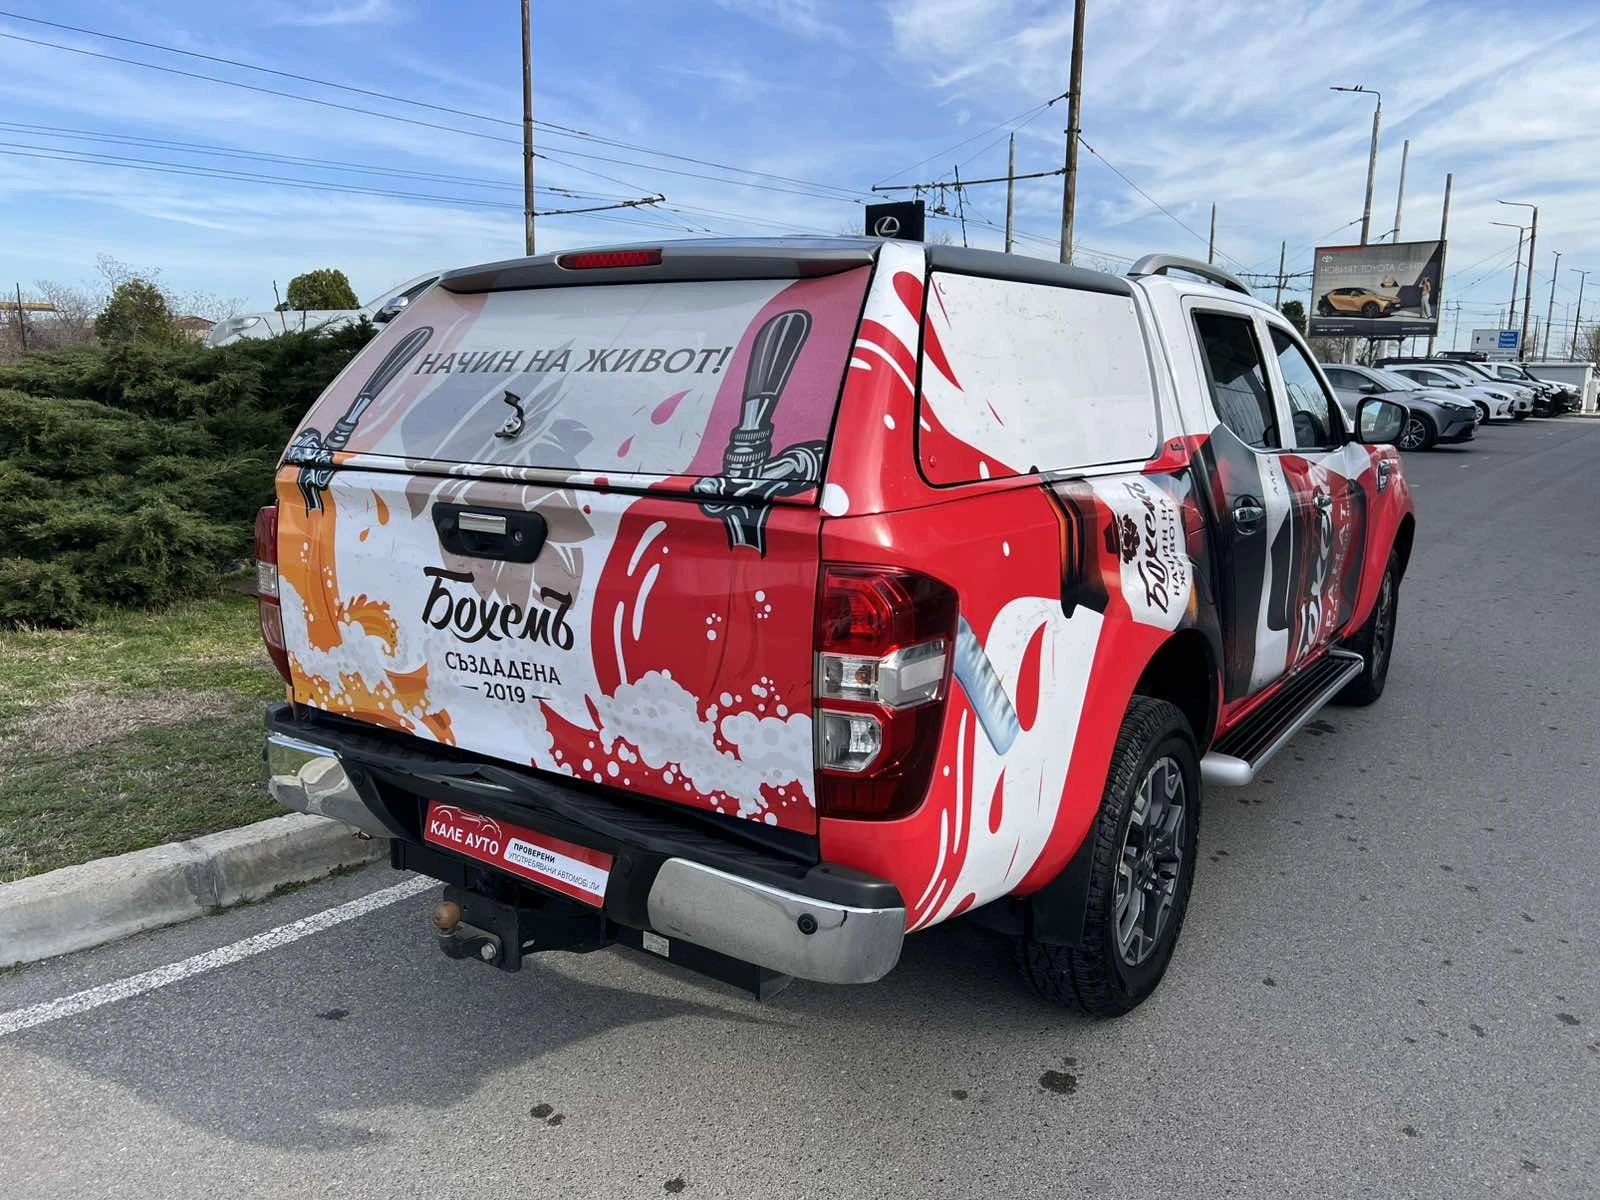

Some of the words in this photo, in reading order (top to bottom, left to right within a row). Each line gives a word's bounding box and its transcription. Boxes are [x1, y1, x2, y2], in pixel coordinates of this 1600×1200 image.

[414, 350, 522, 375] НАЧИН
[523, 349, 572, 374] НА
[574, 346, 733, 374] ЖИВОТ!
[422, 566, 574, 651] Бохемъ
[445, 651, 562, 685] СЪЗДАДЕНА
[484, 682, 526, 703] 2019
[430, 820, 464, 843] КАЛЕ
[465, 832, 499, 855] АУТО
[508, 853, 557, 875] УПОТРЕБЯВАНИ
[513, 843, 555, 863] ПРОВЕРЕНИ
